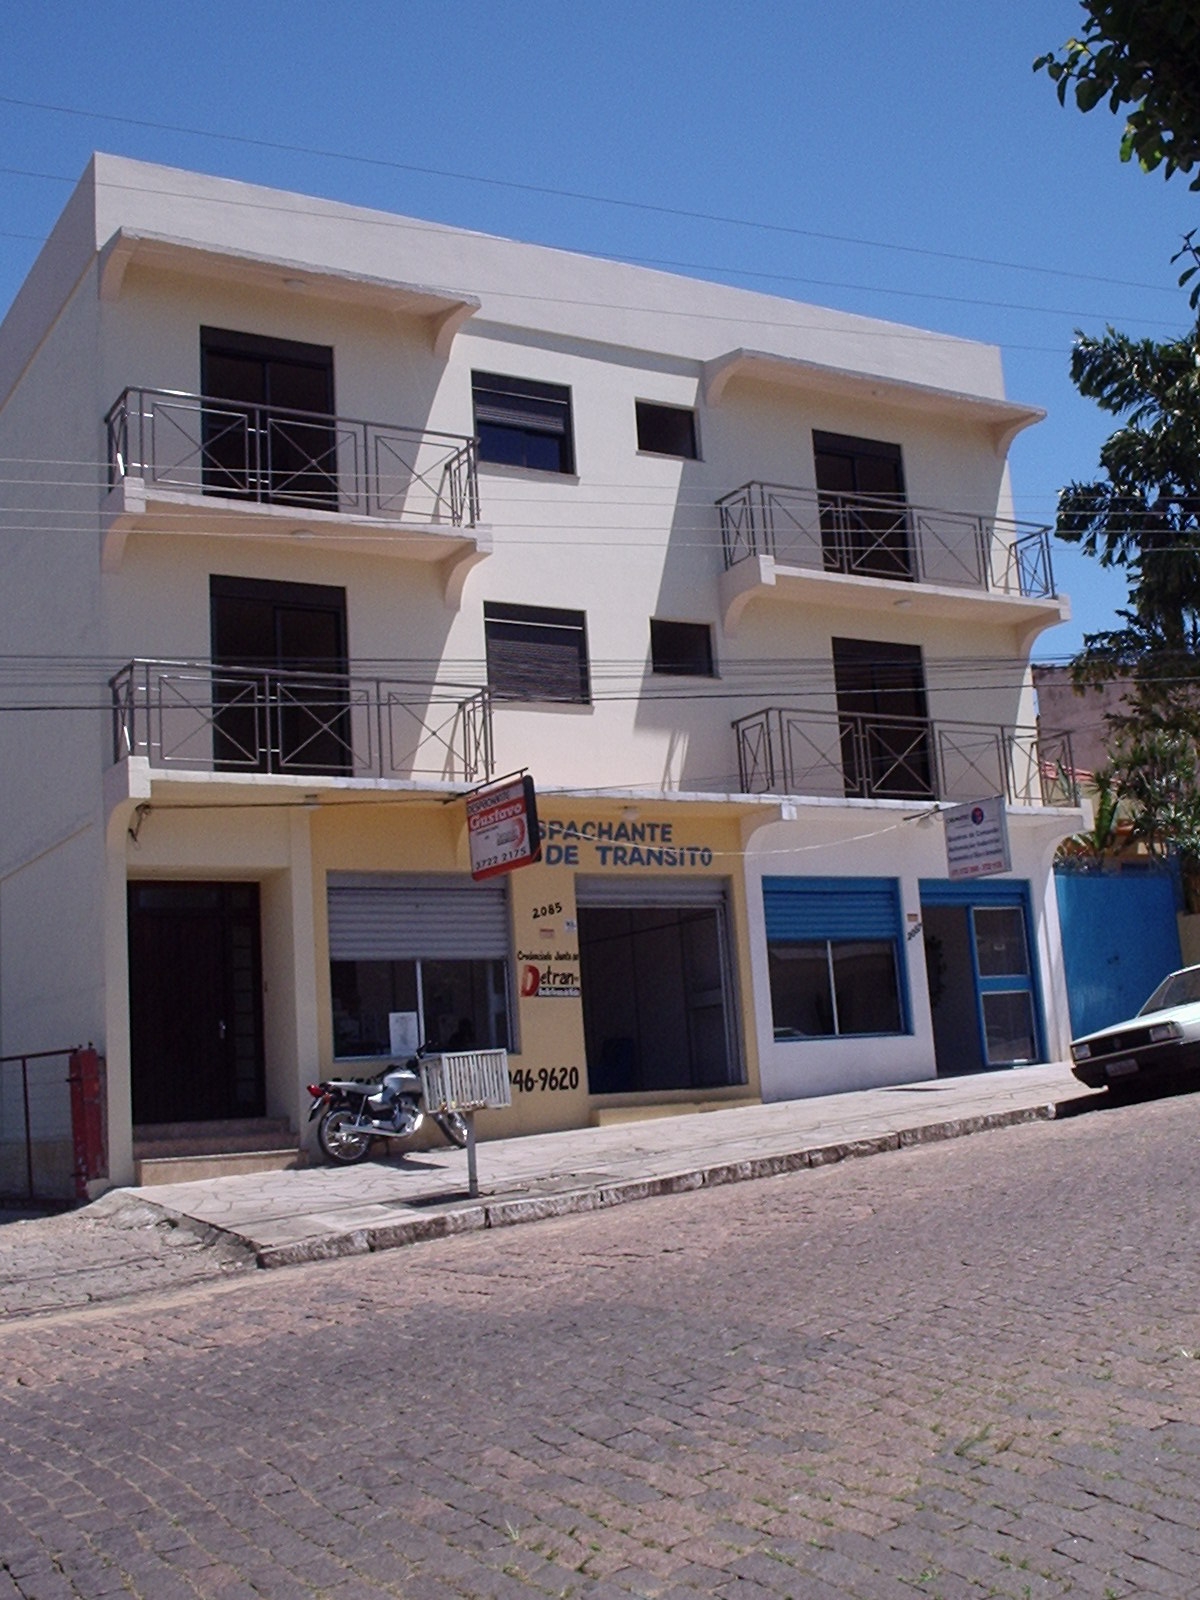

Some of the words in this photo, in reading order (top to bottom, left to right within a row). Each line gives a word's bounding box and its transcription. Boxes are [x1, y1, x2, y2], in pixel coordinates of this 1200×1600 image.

[470, 803, 522, 828] Gustavo
[475, 856, 499, 870] 3722
[502, 847, 527, 861] 2175
[546, 844, 579, 866] DE
[532, 902, 563, 919] 2085
[508, 1066, 579, 1093] 46-9620
